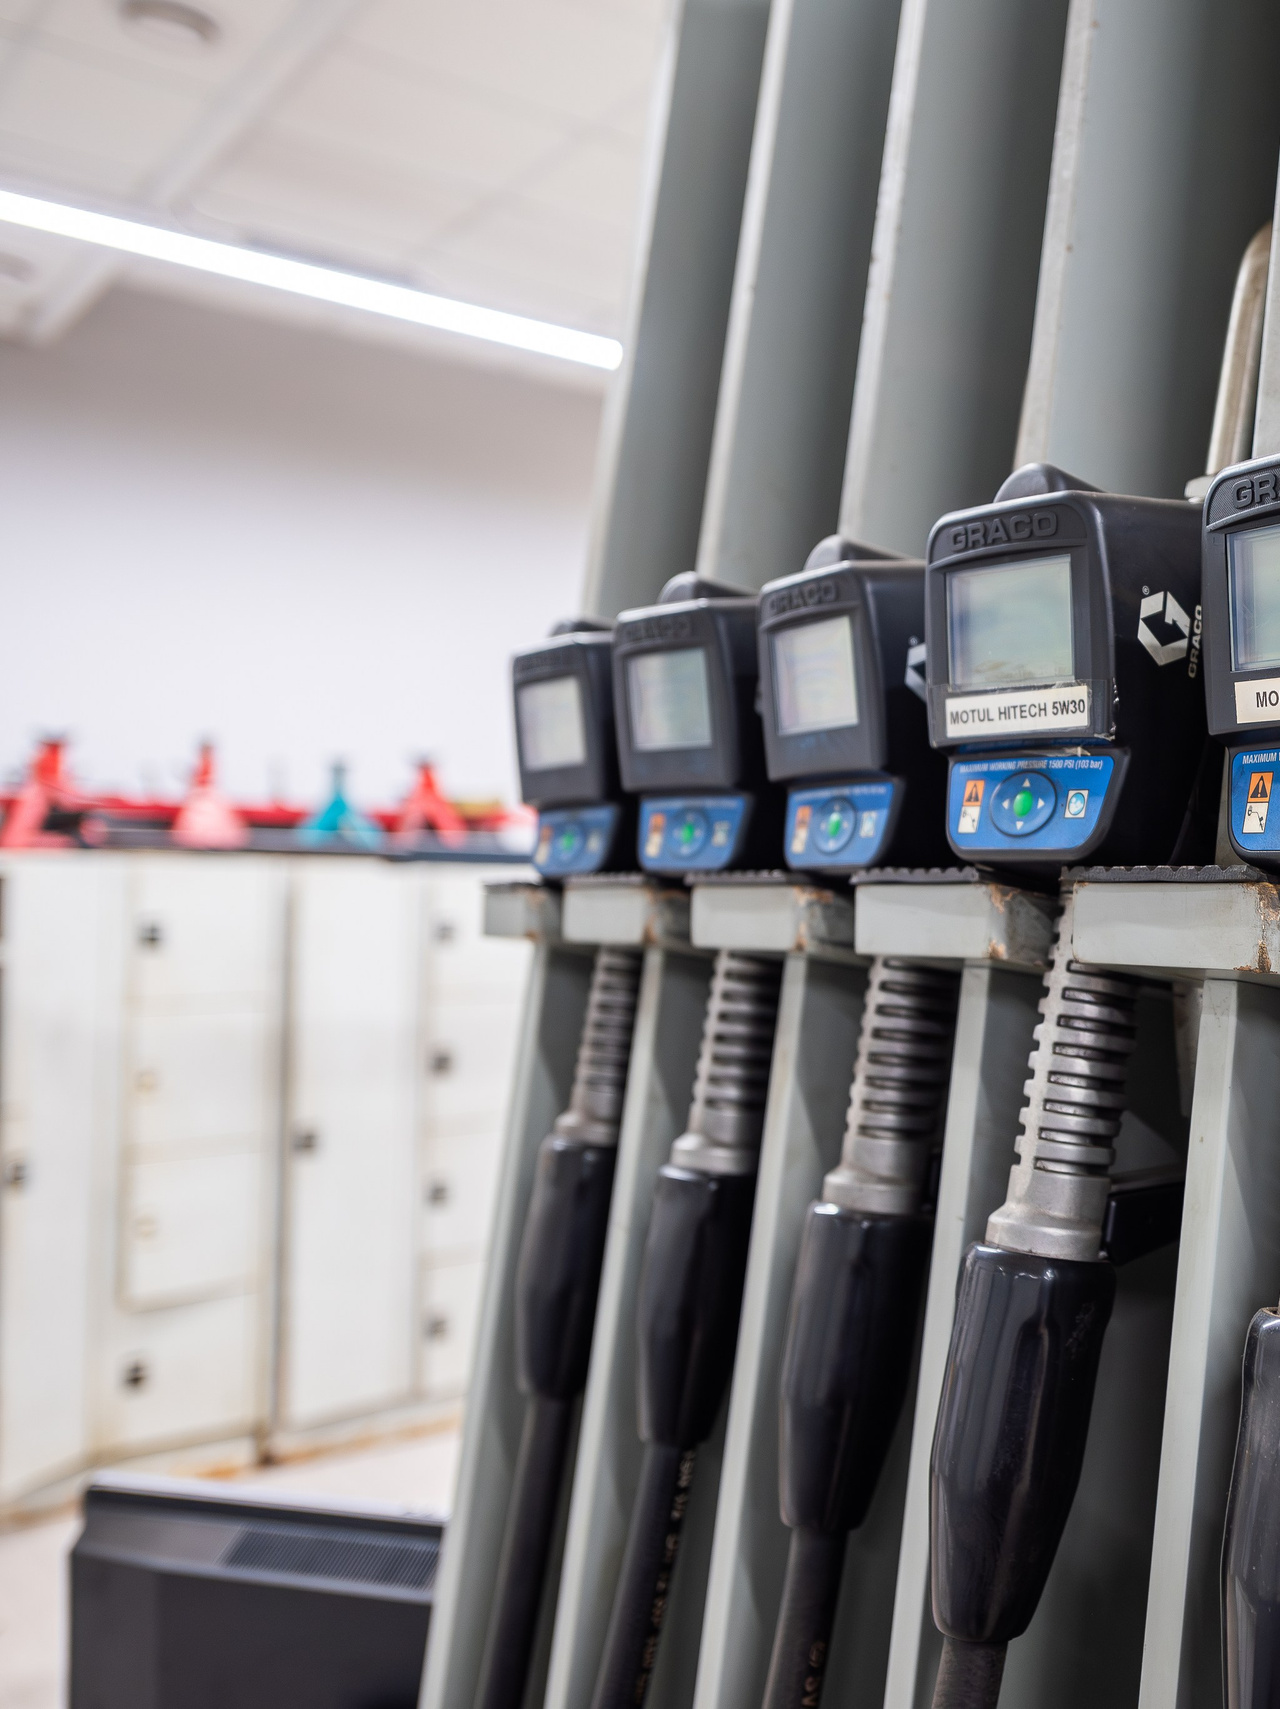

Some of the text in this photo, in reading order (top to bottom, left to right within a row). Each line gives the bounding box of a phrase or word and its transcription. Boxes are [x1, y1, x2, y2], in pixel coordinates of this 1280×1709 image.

[951, 511, 1058, 552] GRACO
[950, 699, 1086, 725] MOTUL HITECH 5W30
[1049, 760, 1063, 769] 1500
[1064, 760, 1074, 769] PSI
[1075, 759, 1090, 770] (103
[1090, 760, 1103, 770] bar)
[1242, 752, 1278, 765] MAXIMUM
